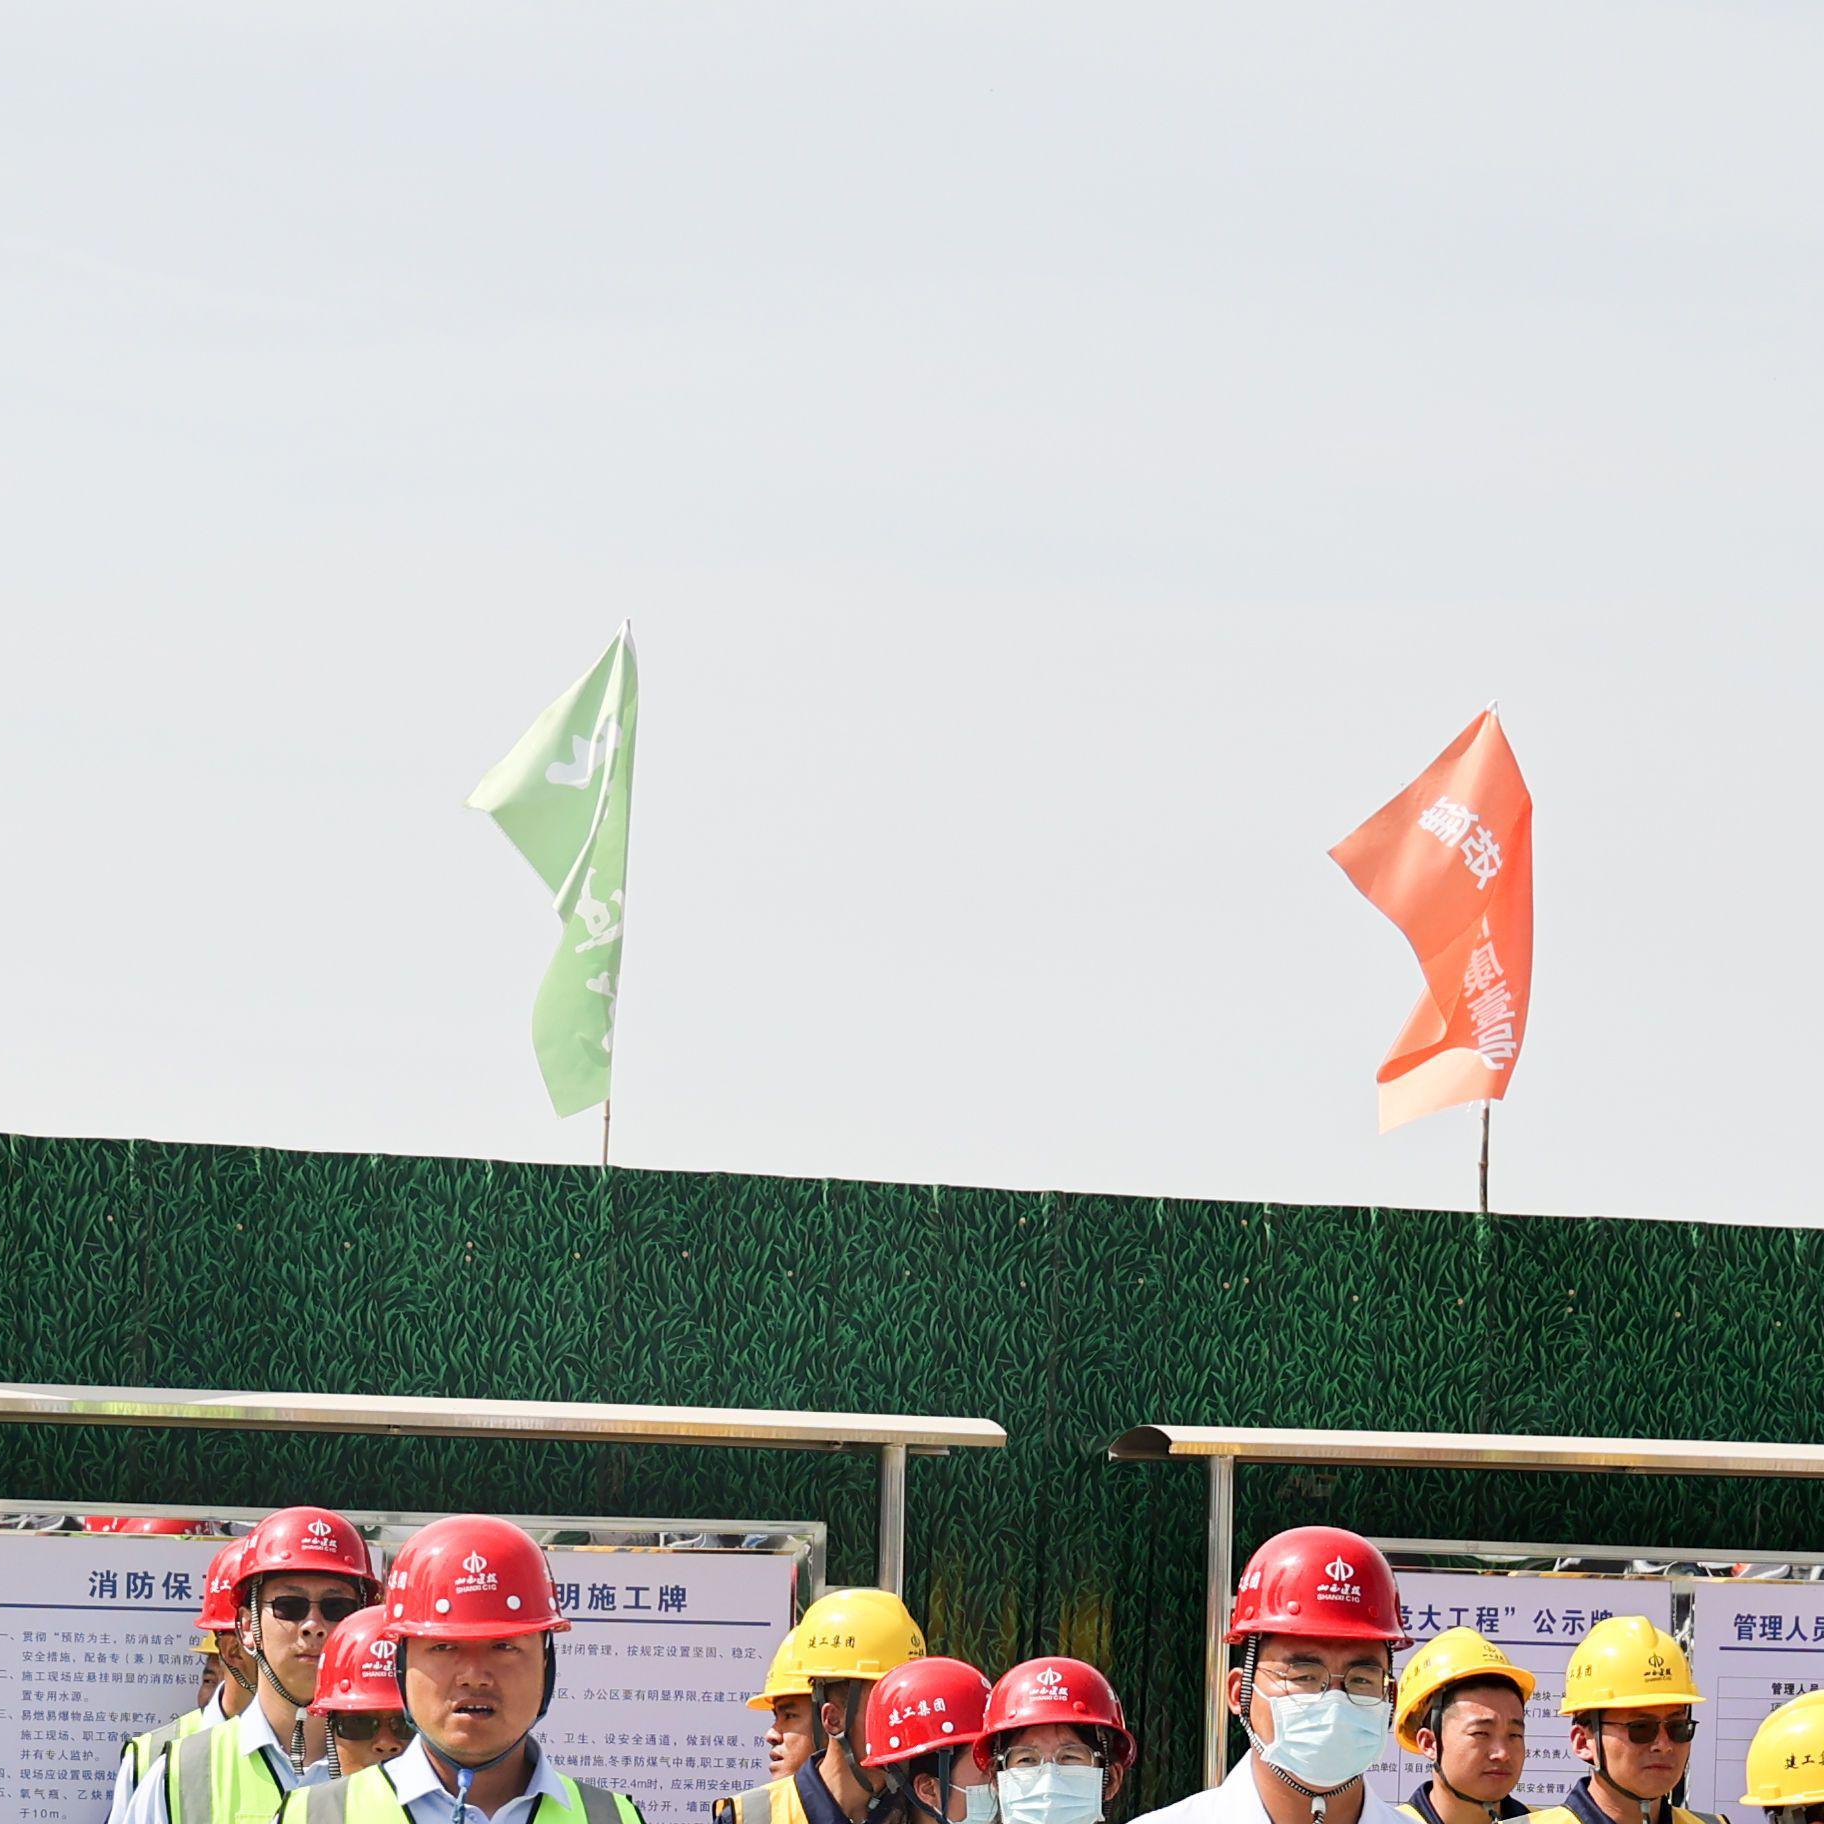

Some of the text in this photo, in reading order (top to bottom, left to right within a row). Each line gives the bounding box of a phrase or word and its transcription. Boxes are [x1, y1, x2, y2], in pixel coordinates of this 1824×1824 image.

[88, 1569, 207, 1600] 消防保
[556, 1582, 688, 1613] 明施工牌
[887, 1697, 947, 1726] 建工集团
